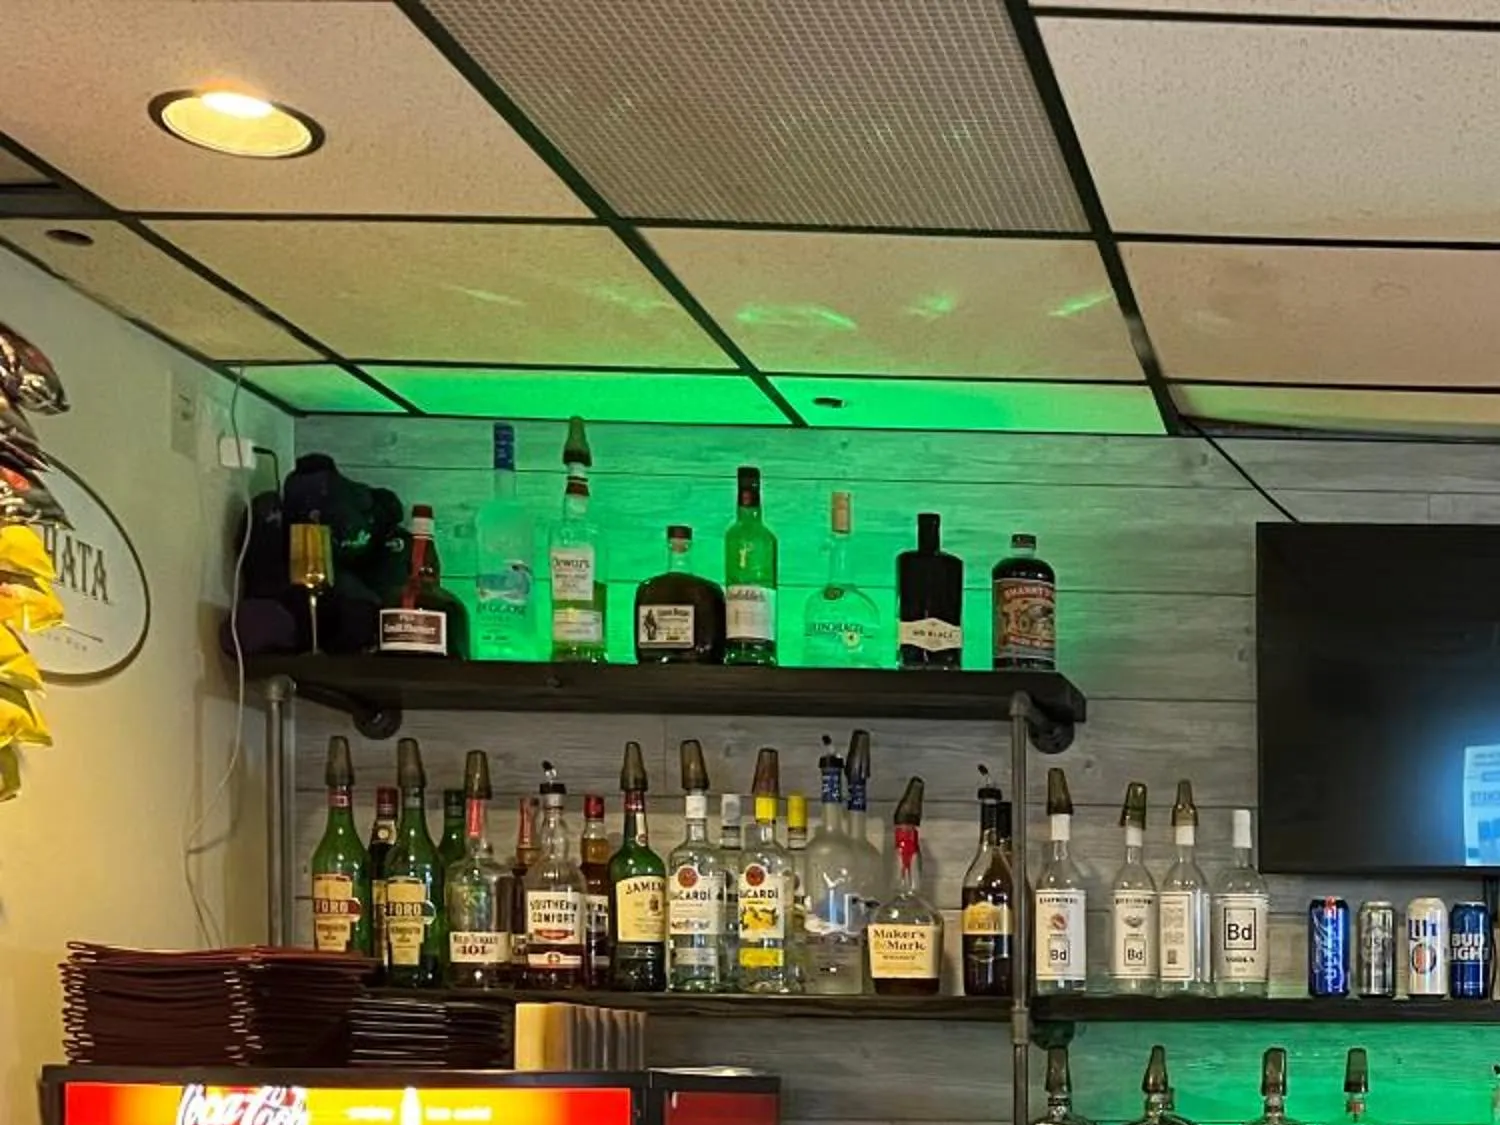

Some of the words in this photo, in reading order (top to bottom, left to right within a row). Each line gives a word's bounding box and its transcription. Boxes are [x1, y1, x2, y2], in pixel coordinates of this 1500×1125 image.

[530, 899, 577, 912] SOUTHERN
[532, 912, 576, 924] COMFORT
[873, 929, 926, 939] Maker's
[1227, 923, 1252, 941] Bd
[886, 939, 927, 951] Mark
[1452, 933, 1485, 947] BUD
[1451, 947, 1488, 960] IGHT
